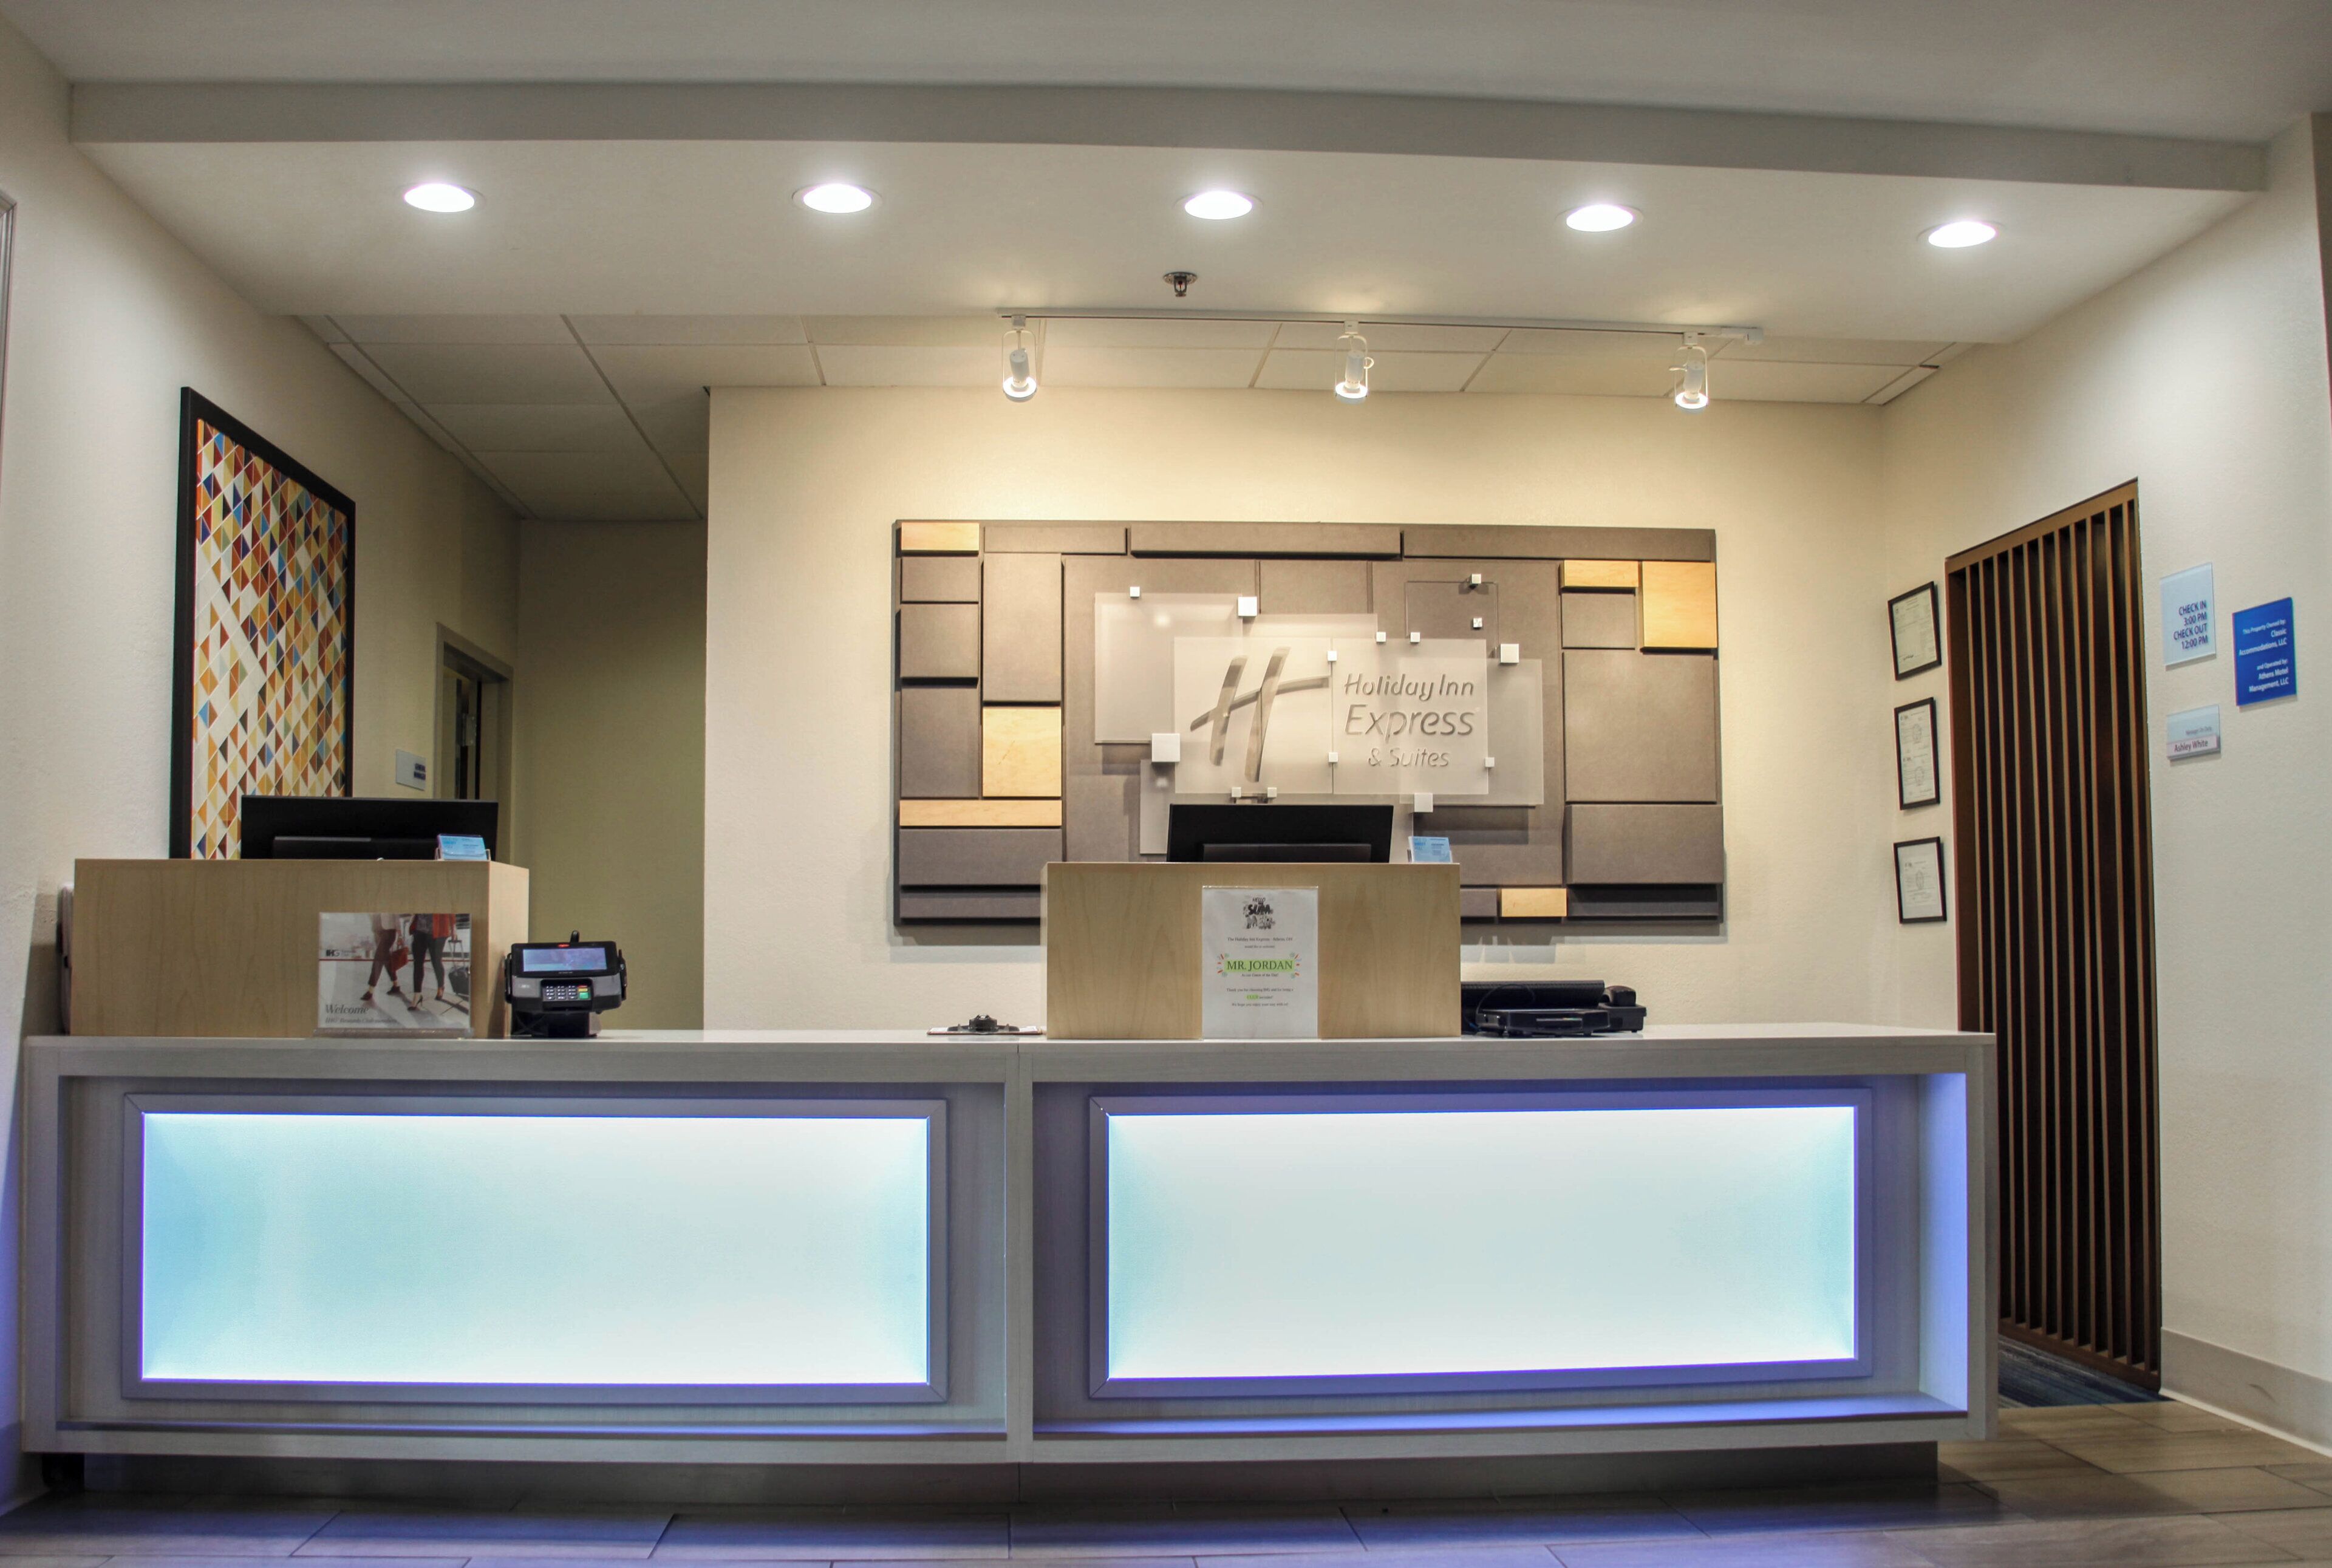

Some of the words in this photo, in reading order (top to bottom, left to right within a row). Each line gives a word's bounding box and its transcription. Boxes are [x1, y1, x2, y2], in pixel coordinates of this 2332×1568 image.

[2178, 602, 2198, 616] CHECK
[2200, 600, 2207, 610] IN
[2184, 615, 2196, 626] 3:00
[2197, 612, 2207, 621] PM
[2173, 627, 2193, 641] CHECK
[2194, 623, 2208, 635] OUT
[2271, 628, 2286, 638] Classic
[2181, 638, 2197, 650] 12:00
[2198, 635, 2208, 644] PM
[2259, 671, 2274, 680] Athens
[2274, 667, 2288, 676] Motel
[1344, 673, 1434, 702] Holiday
[1439, 673, 1474, 696] Inn
[2280, 677, 2289, 686] LLC
[1345, 704, 1475, 744] Express
[2174, 742, 2191, 752] Ashley
[2192, 740, 2208, 749] White
[1368, 748, 1382, 767] &
[1389, 748, 1450, 767] Suites
[1227, 960, 1246, 970] MR.
[1248, 960, 1293, 972] JORDAN
[326, 1004, 369, 1014] Welcome
